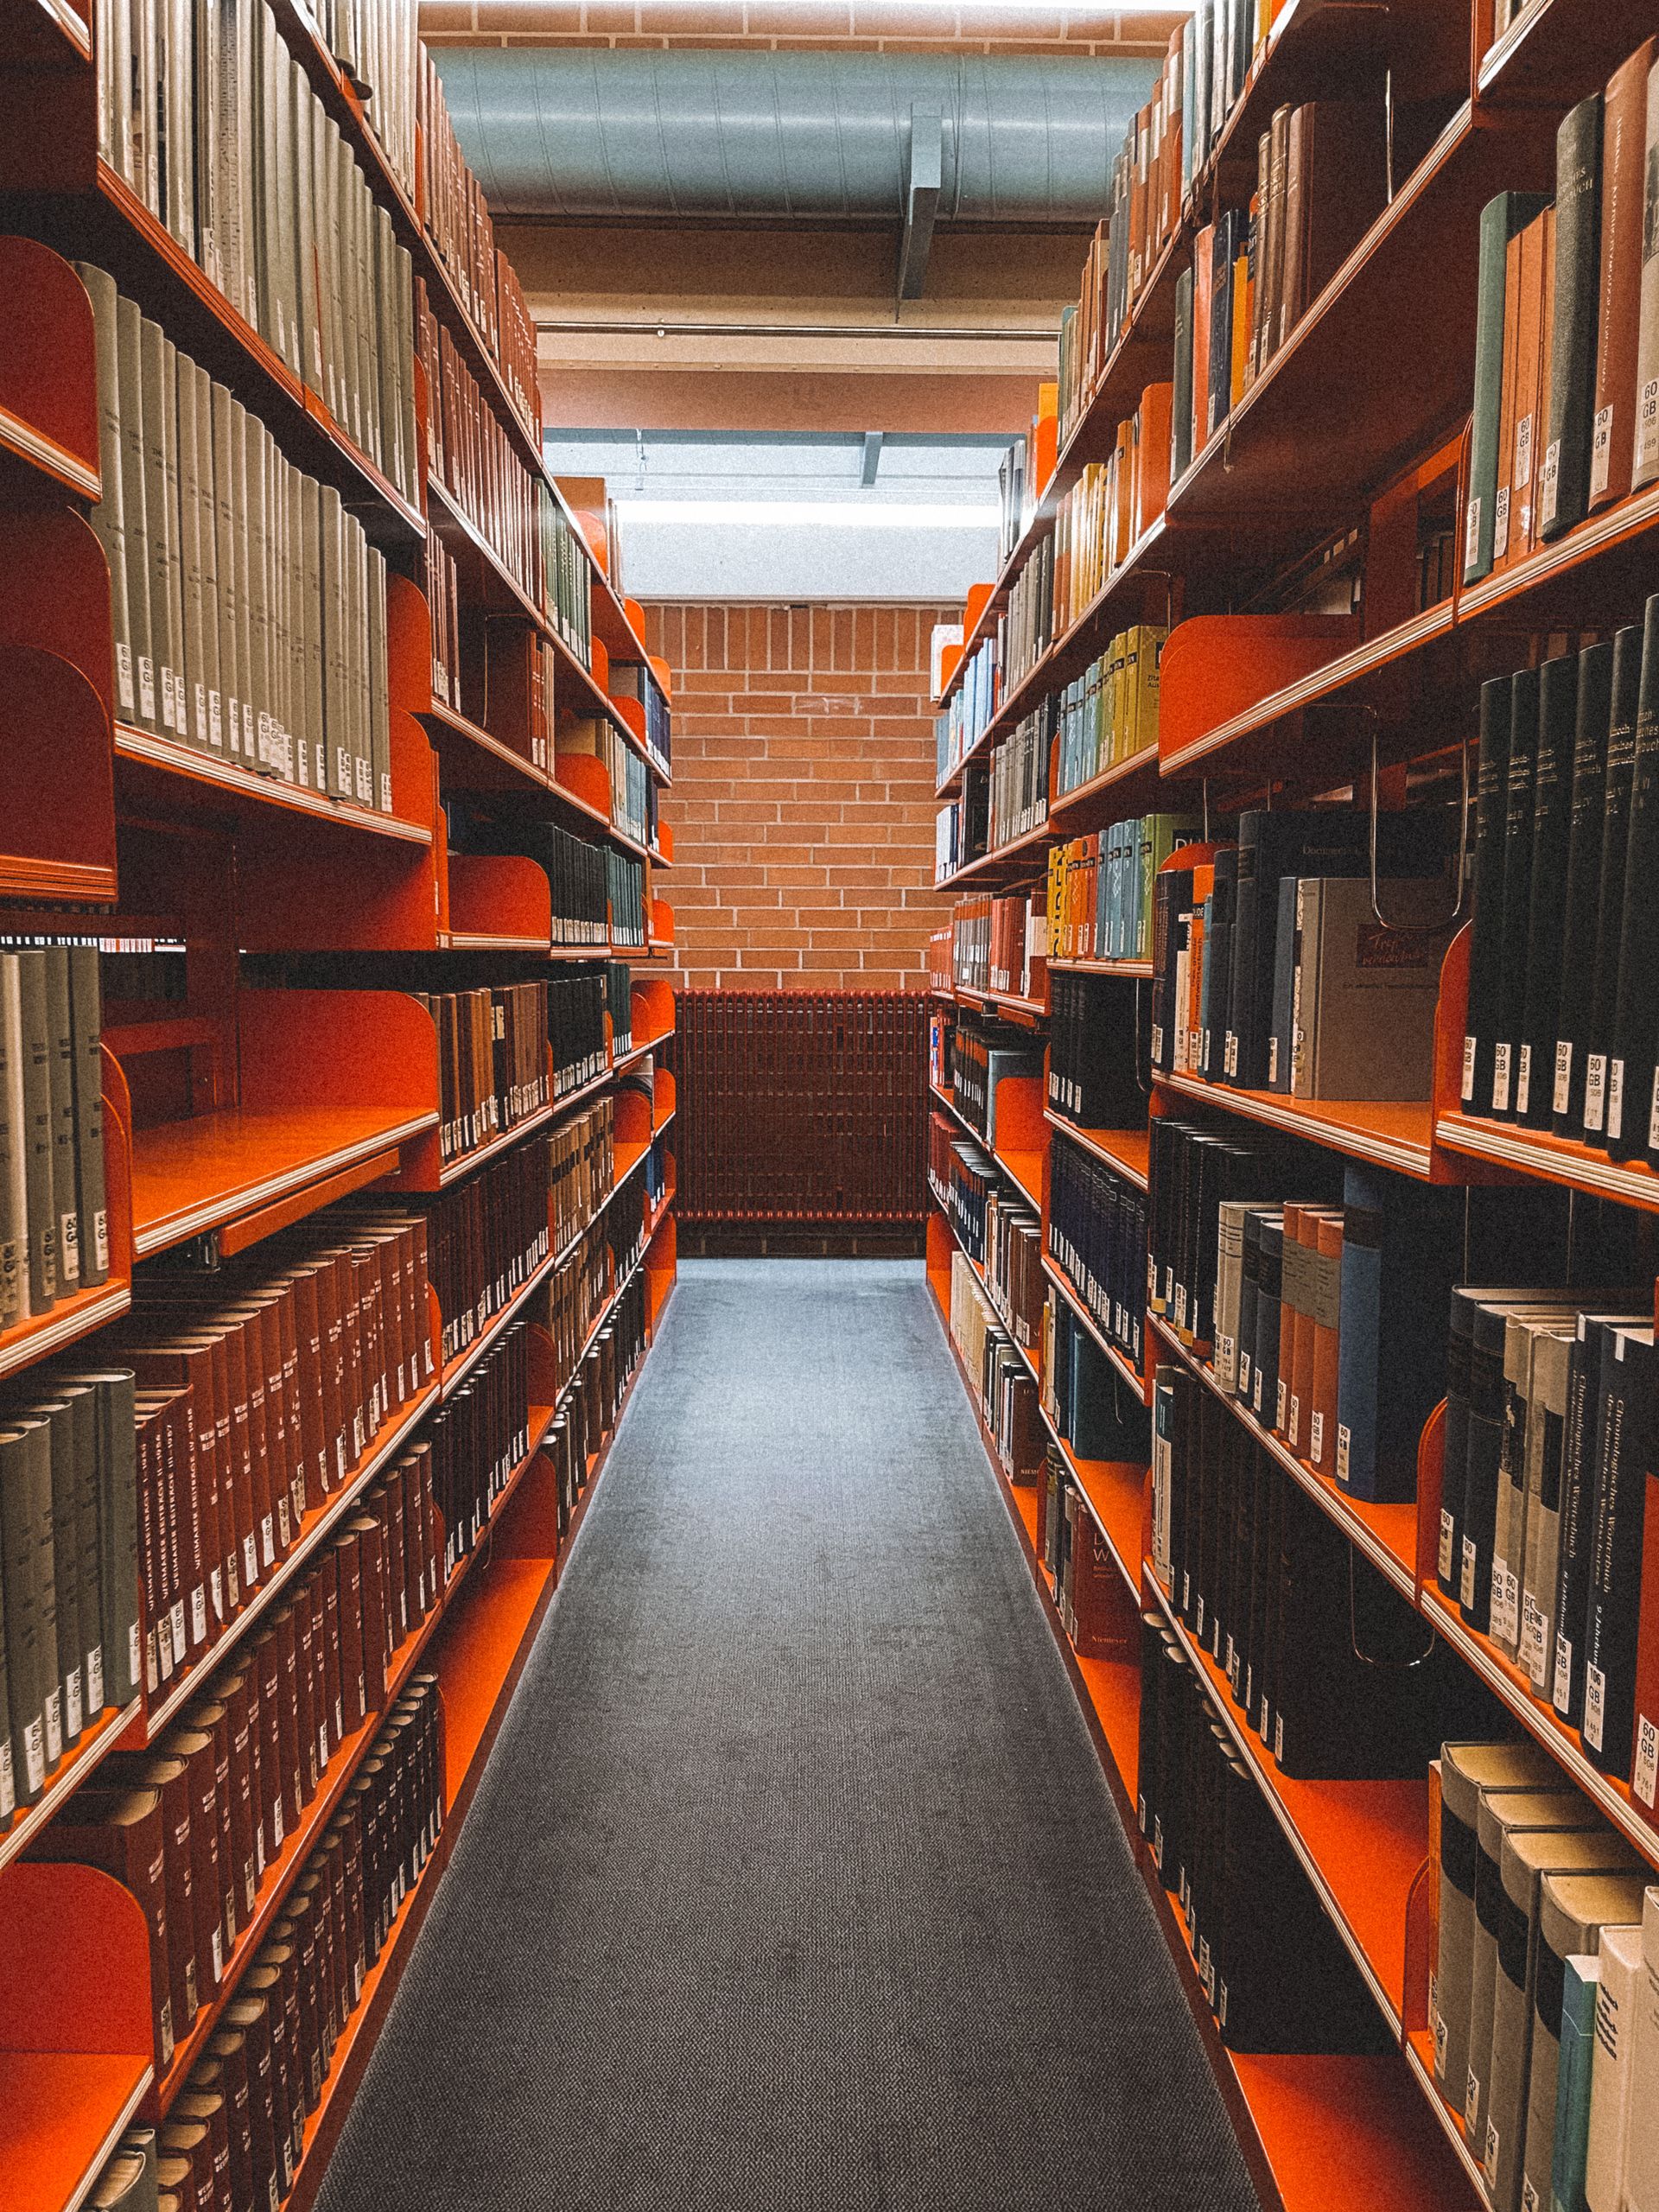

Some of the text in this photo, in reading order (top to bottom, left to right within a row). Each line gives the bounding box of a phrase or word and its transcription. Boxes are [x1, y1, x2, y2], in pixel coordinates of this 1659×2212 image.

[1644, 381, 1658, 399] 60
[1598, 409, 1608, 426] 60
[1643, 401, 1656, 418] GB
[1521, 418, 1529, 432] 60
[1519, 433, 1529, 448] GB
[1595, 432, 1607, 448] GB
[1497, 492, 1508, 503] 60
[1497, 505, 1507, 518] GB
[1496, 1046, 1506, 1057] 60
[1558, 1044, 1567, 1056] 60
[1590, 1058, 1601, 1071] 60
[1589, 1074, 1600, 1086] GB
[1601, 1421, 1612, 1492] deutschen
[1568, 1374, 1586, 1559] Chronologisches Wörterbuch
[189, 1456, 198, 1508] BEITRÄGE
[167, 1472, 176, 1526] BEITRÄGE
[1603, 1397, 1624, 1594] Chronologisches Wörterbuch
[157, 1480, 166, 1535] BEITRÄGE
[143, 1490, 151, 1546] BEITRÄGE
[192, 1512, 201, 1570] WEIMARER
[171, 1529, 180, 1590] WEIMARER
[160, 1540, 168, 1599] WEIMARER
[146, 1548, 155, 1611] WEIMARER
[1506, 1574, 1516, 1590] 60
[1491, 1585, 1503, 1599] GB
[1506, 1589, 1516, 1605] GB
[1091, 1635, 1128, 1645] Niemeyer
[1557, 1652, 1567, 1670] GB
[1590, 1667, 1602, 1687] 106
[1589, 1685, 1601, 1705] GB
[1643, 1721, 1656, 1742] 60
[1641, 1739, 1655, 1759] GB
